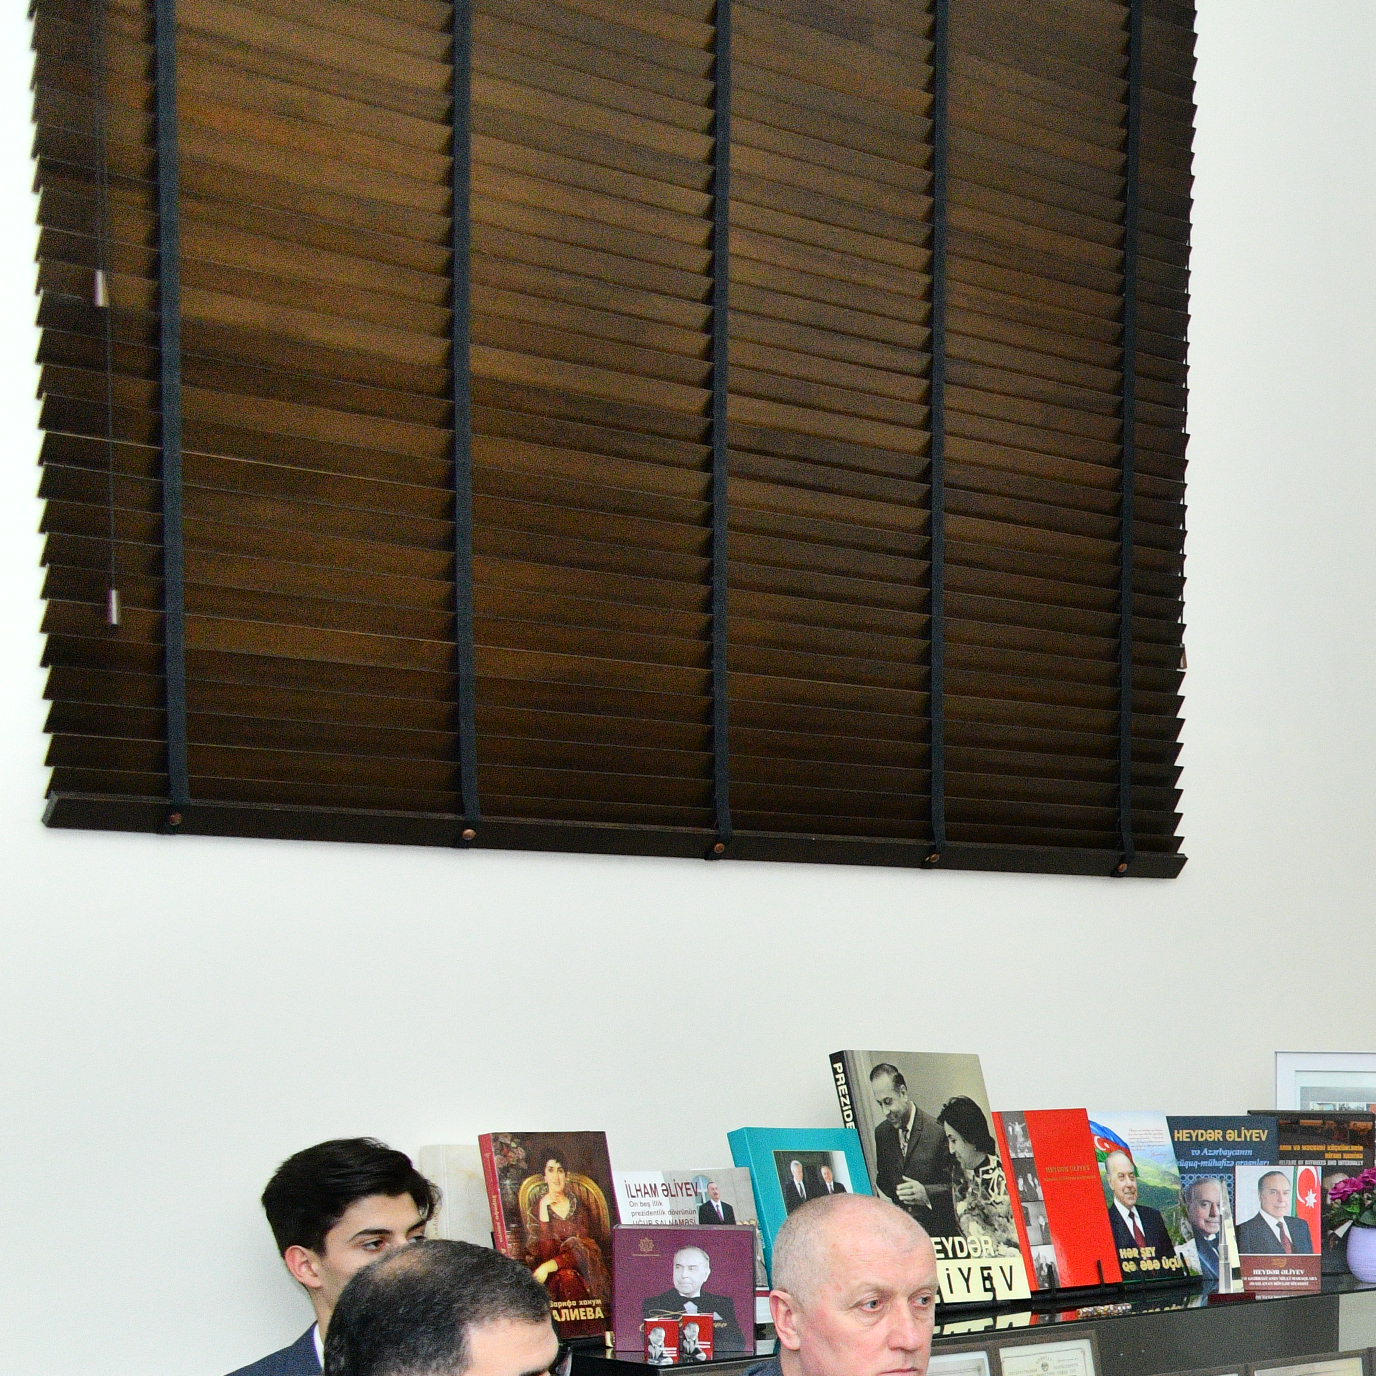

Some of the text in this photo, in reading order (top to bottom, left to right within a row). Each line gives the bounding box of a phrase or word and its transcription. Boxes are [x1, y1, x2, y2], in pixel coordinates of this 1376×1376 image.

[1174, 1129, 1223, 1142] HEYDƏR
[1225, 1126, 1269, 1142] ƏLİYEV
[1177, 1159, 1235, 1169] üquq-mühafizə
[624, 1178, 699, 1199] İLHAM ƏLİYEV
[930, 1236, 995, 1259] EYDƏR
[945, 1264, 1013, 1295] İYEV
